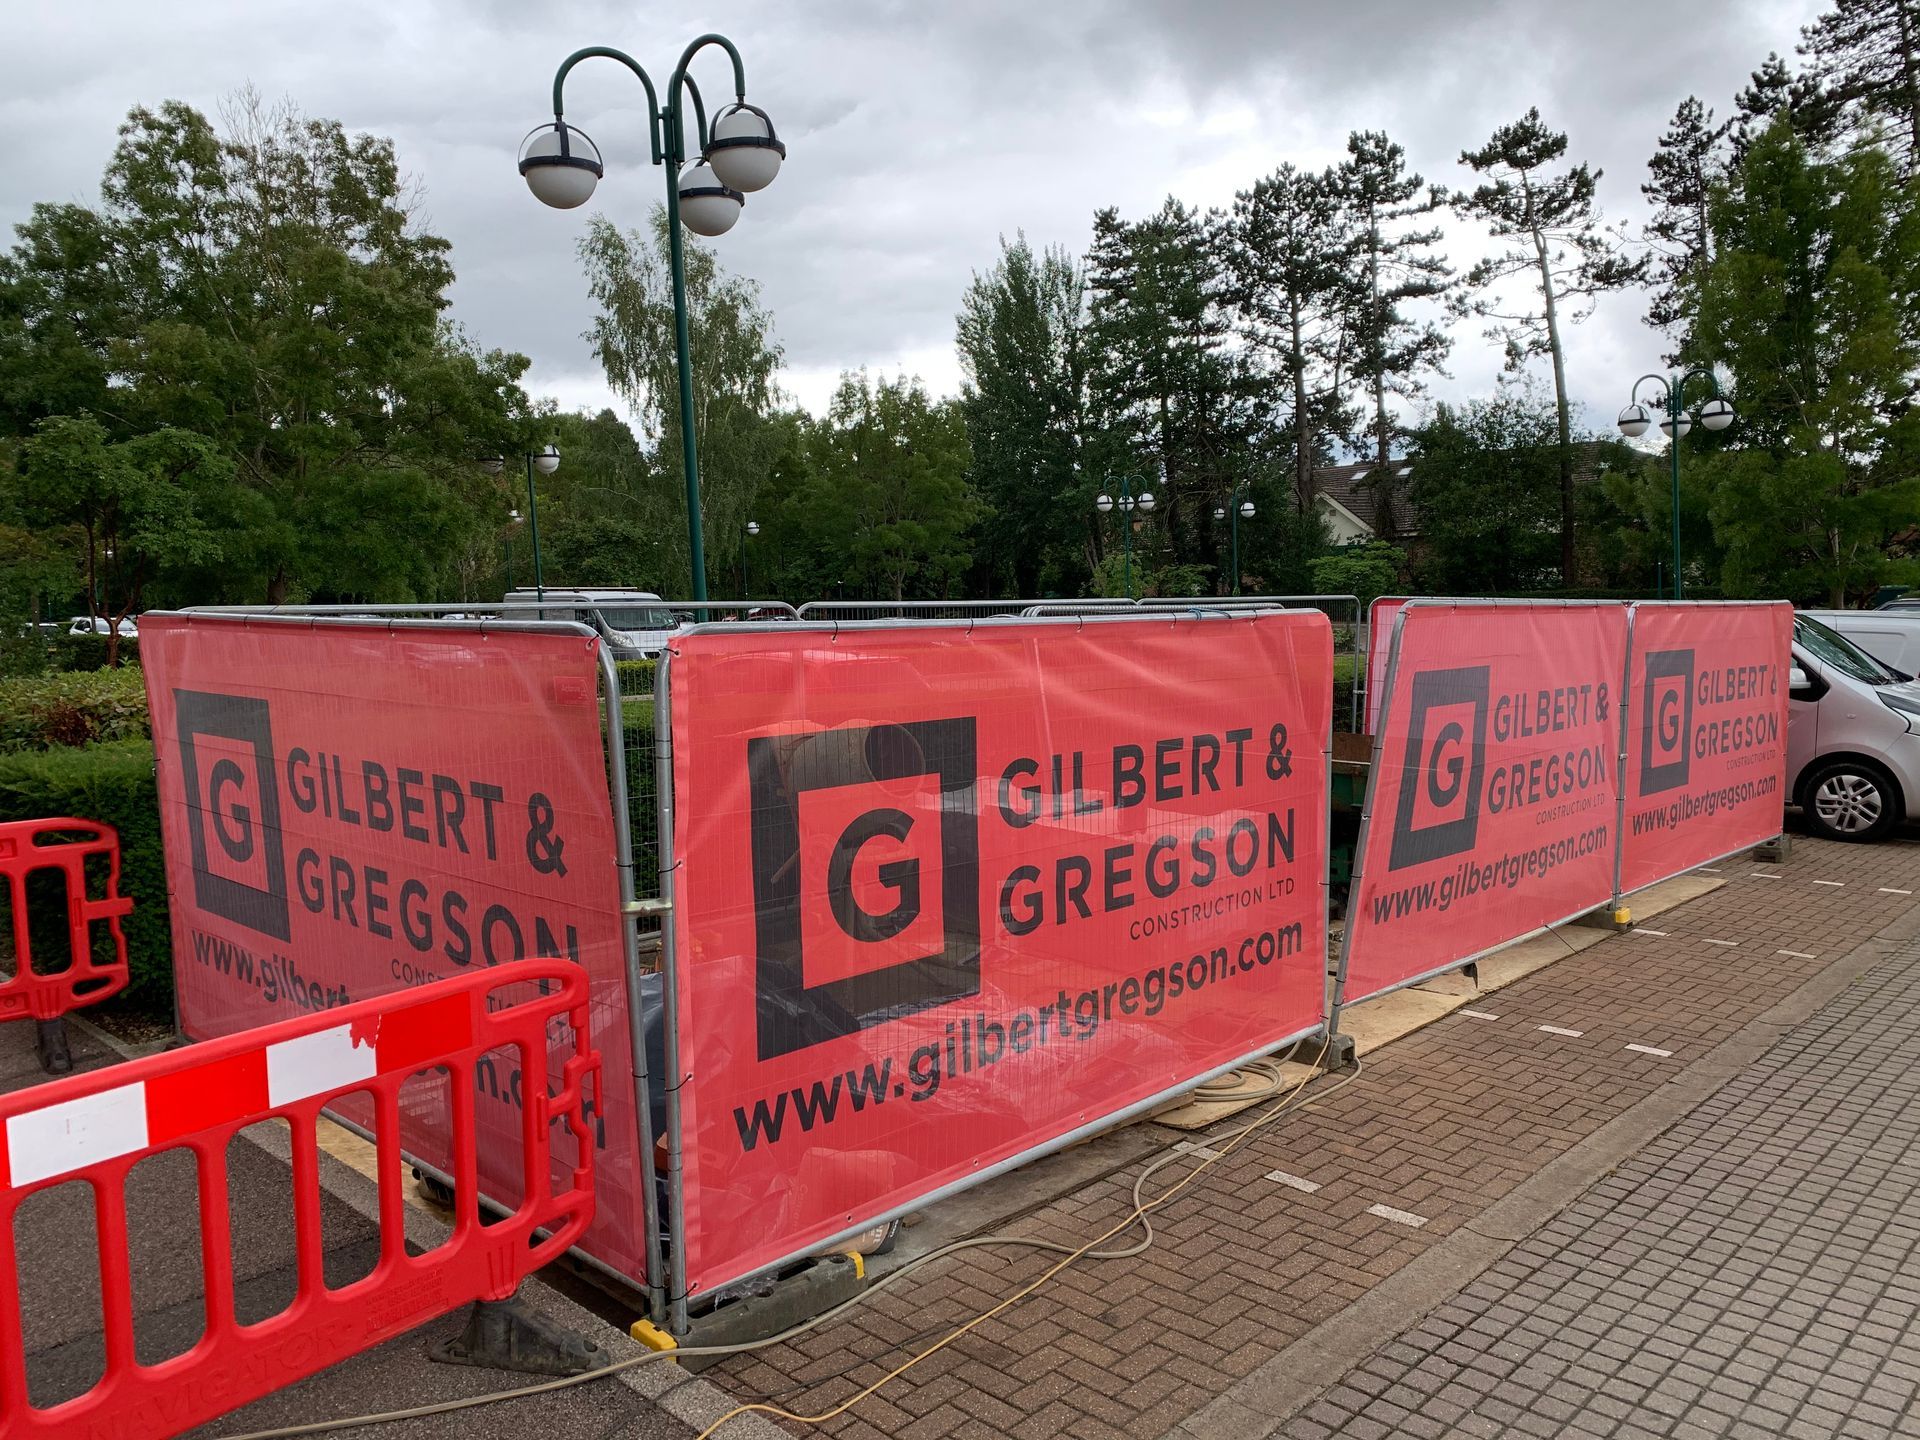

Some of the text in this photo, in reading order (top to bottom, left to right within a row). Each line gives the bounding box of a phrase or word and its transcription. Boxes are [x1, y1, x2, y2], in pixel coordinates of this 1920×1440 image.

[1494, 682, 1609, 743] GILBERT &
[1658, 689, 1679, 752] G
[1698, 665, 1768, 706] GILBERT
[1428, 722, 1464, 807] G
[1695, 712, 1778, 759] GREGSON
[1726, 749, 1776, 771] CONSTRUCTION LTD
[209, 759, 253, 863] G
[287, 747, 567, 877] GILBERT &
[998, 723, 1293, 829] GILBERT &
[1488, 744, 1605, 814] GREGSON
[1536, 793, 1605, 825] CONSTRUCTION LTD
[1632, 774, 1776, 836] www.gilbertgregson.com
[827, 808, 920, 942] G
[1000, 808, 1295, 936] GREGSON
[1130, 877, 1295, 940] CONSTRUCTION LTD
[1373, 824, 1606, 925] www.gilbertgregson.com
[296, 848, 580, 995] GREGSON
[733, 919, 1302, 1152] www.gilbertgregson.com
